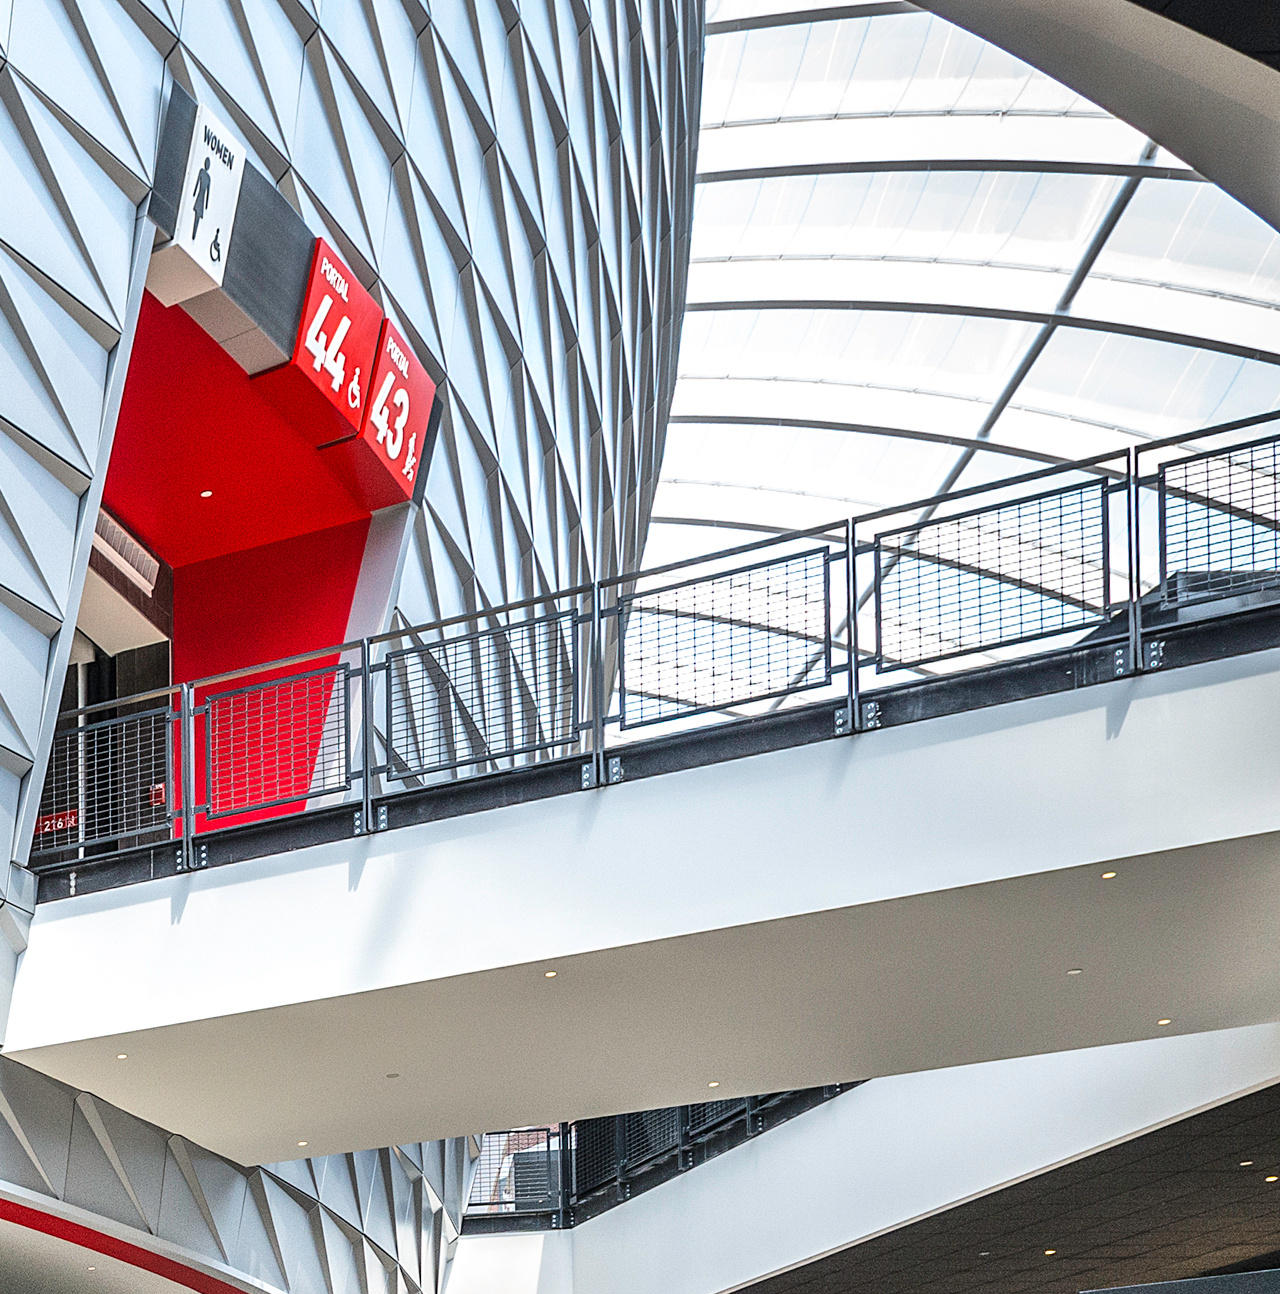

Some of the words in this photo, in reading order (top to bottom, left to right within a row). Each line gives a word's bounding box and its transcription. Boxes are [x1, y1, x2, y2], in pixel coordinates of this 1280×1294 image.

[203, 125, 235, 171] WOMEN
[320, 257, 349, 303] PORTAL
[303, 294, 352, 392] 44
[386, 336, 409, 380] PORTAL
[370, 371, 410, 460] 43
